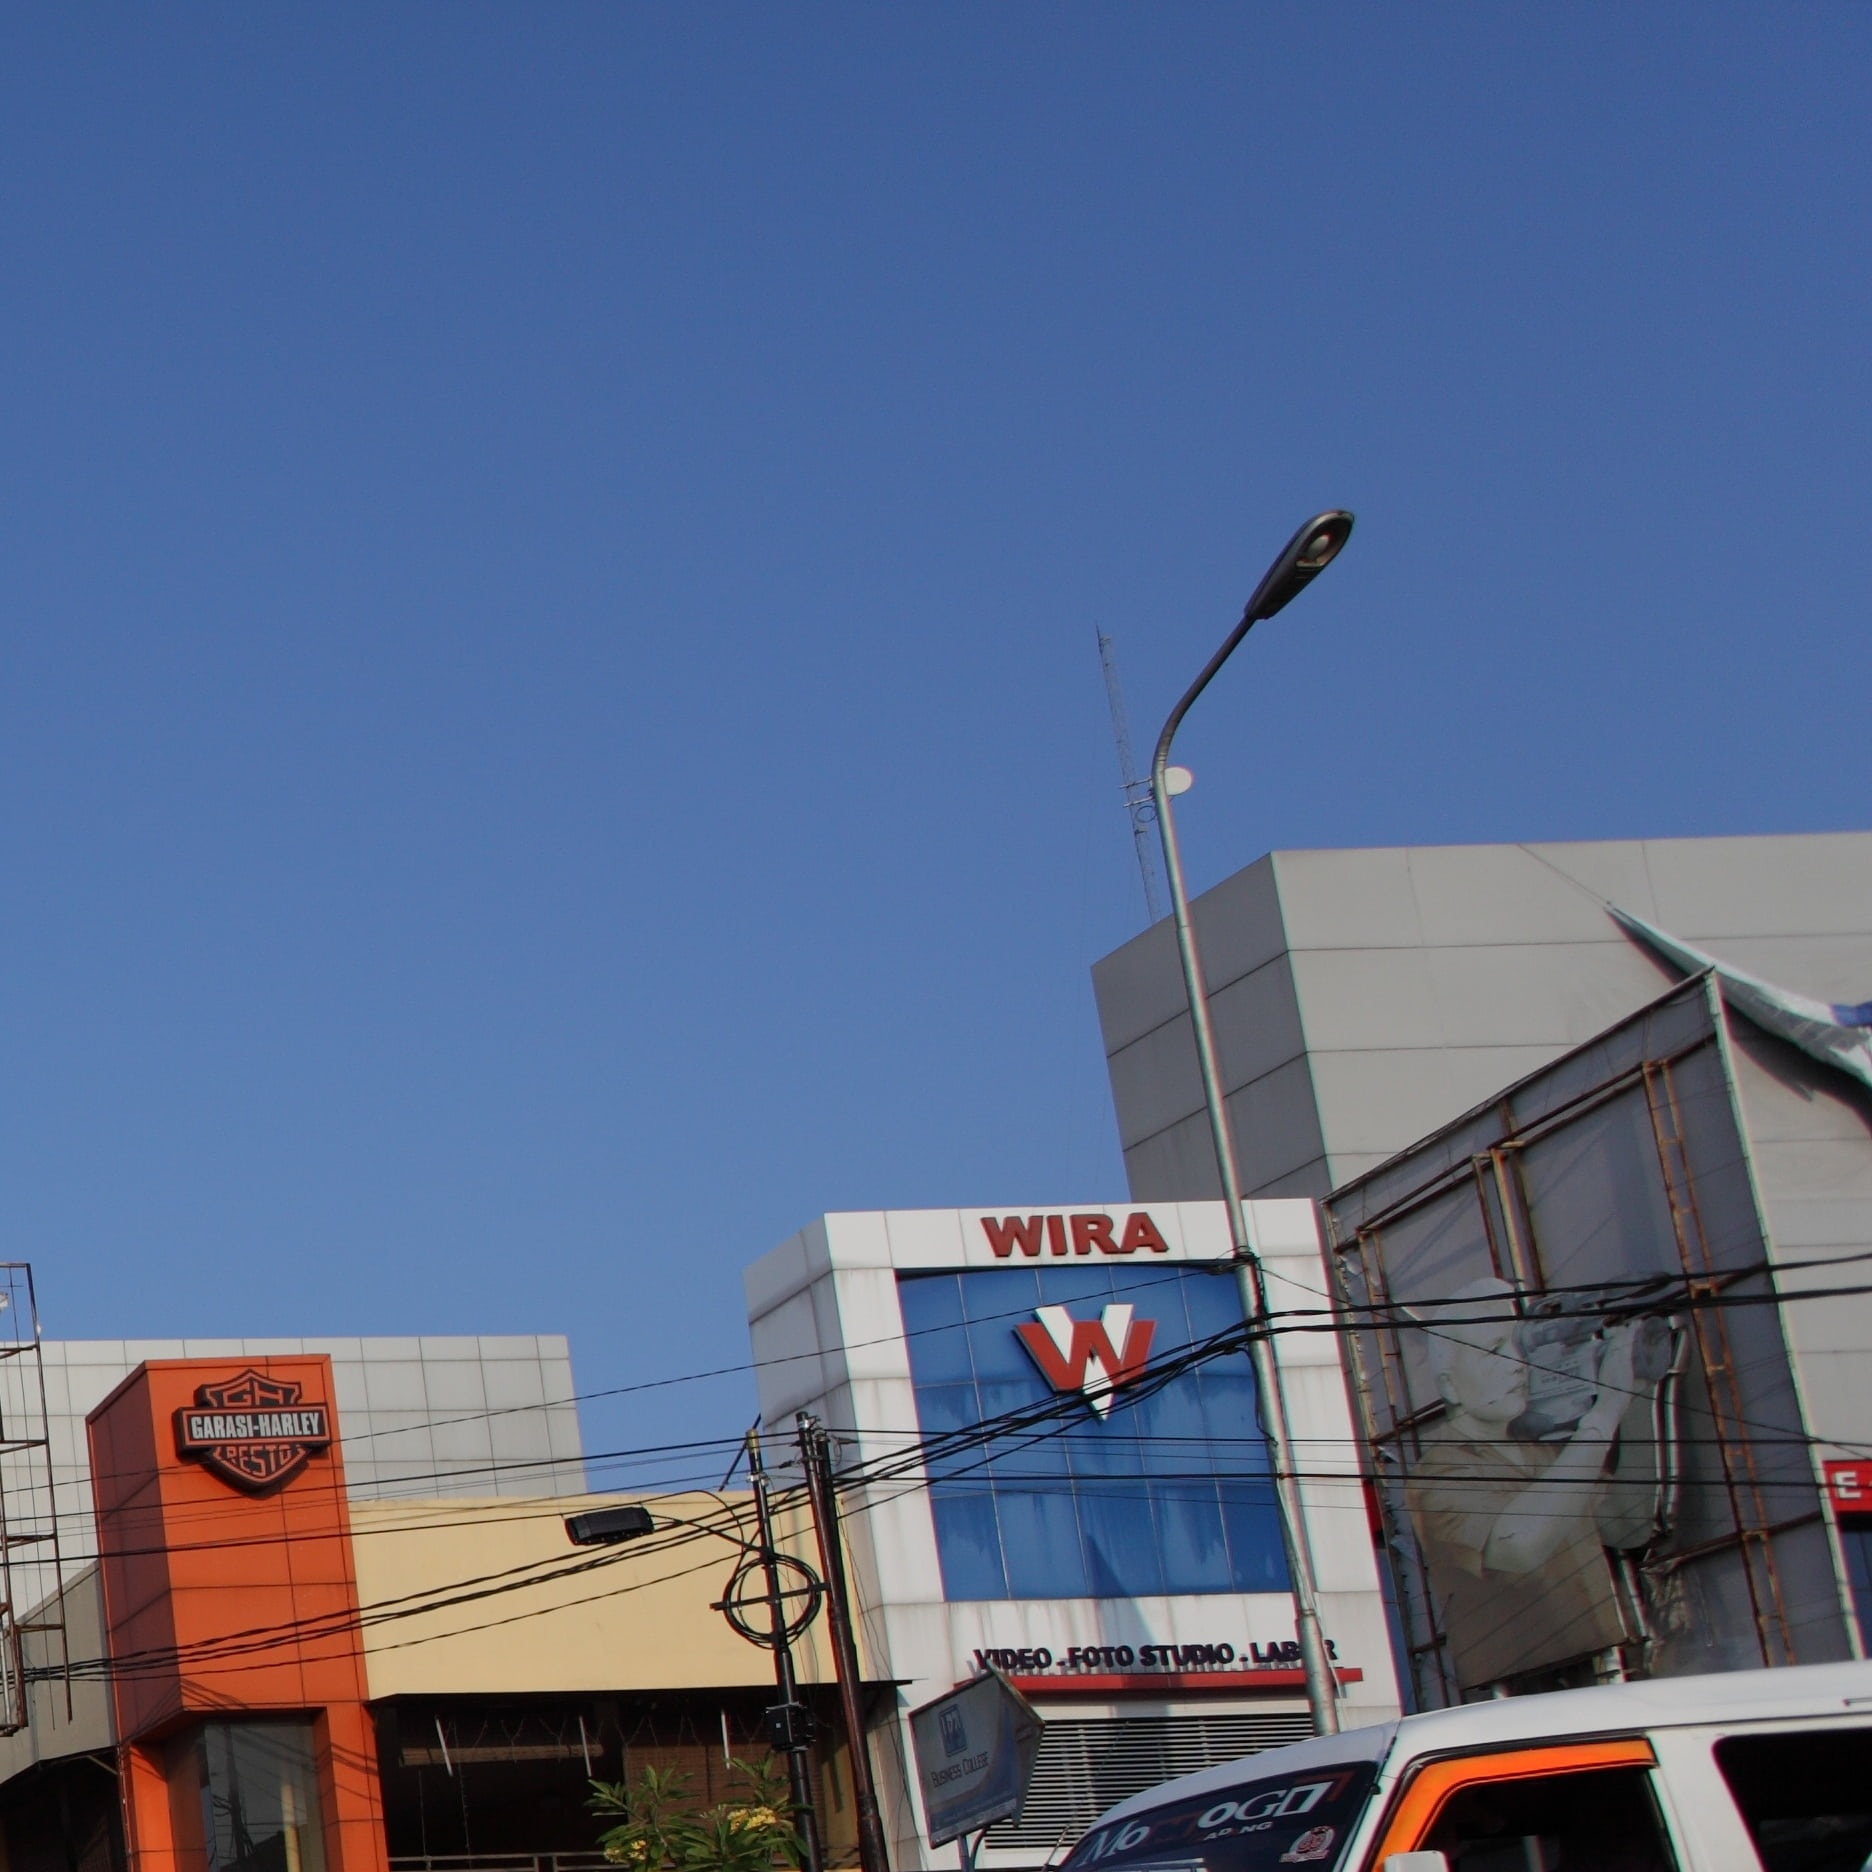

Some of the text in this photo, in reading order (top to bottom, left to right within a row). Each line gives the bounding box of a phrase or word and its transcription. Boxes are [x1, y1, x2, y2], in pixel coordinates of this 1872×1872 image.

[980, 1211, 1170, 1258] WIRA
[191, 1412, 319, 1440] GARASI-HARLEY
[974, 1639, 1338, 1672] VIDEO FOTO STUDIO LABR
